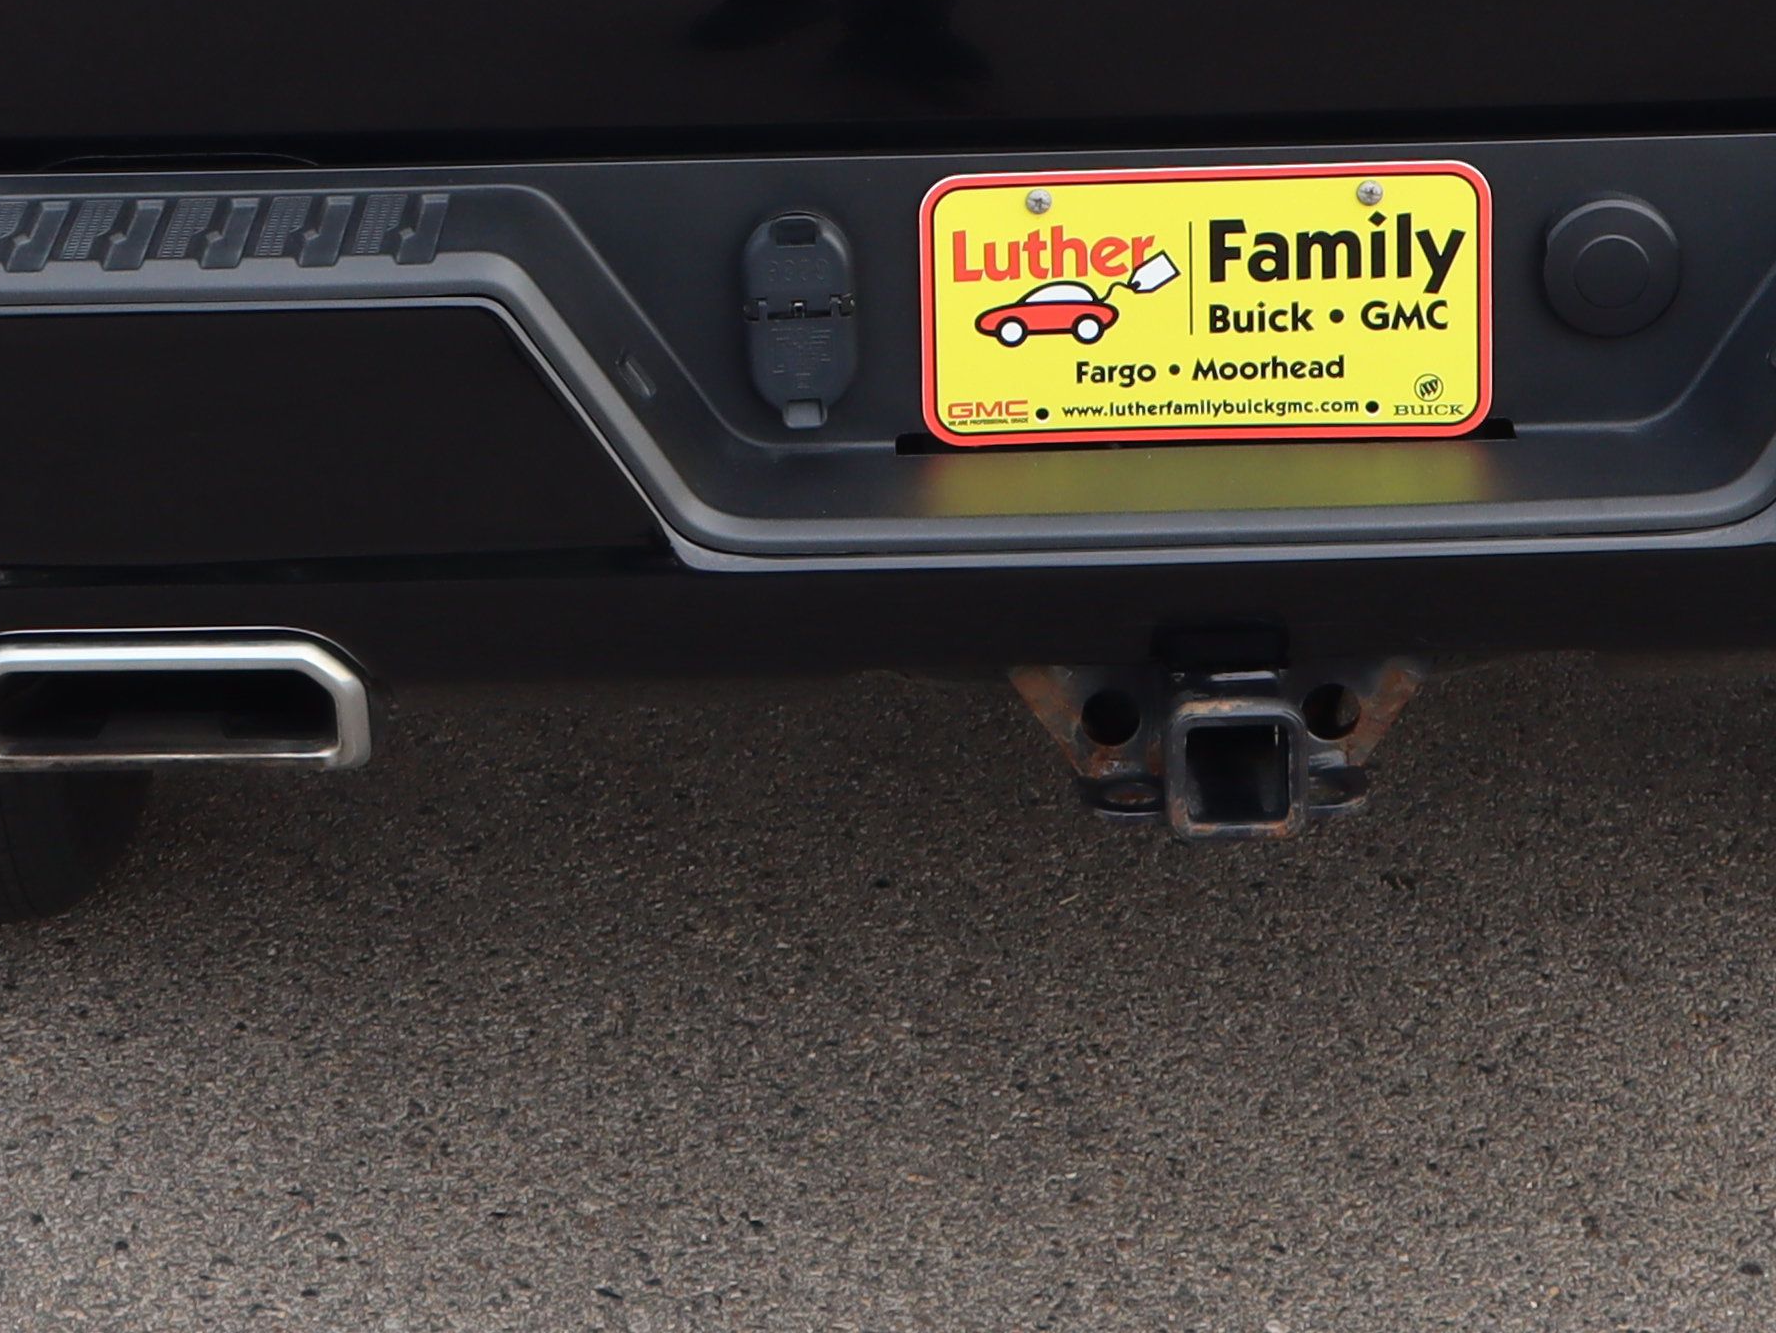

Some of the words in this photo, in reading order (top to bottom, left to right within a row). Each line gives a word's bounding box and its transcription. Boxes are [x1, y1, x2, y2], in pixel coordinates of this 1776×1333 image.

[952, 225, 1155, 283] Luther
[1208, 210, 1466, 294] Family
[1208, 300, 1315, 335] Buick
[1360, 300, 1449, 332] GMC
[1076, 361, 1157, 388] Fargo
[1192, 354, 1345, 382] Moorhead
[948, 400, 1029, 419] GMC
[1062, 399, 1359, 418] www.lutherfamilybuickgmc.com
[1393, 404, 1464, 416] BUICK
